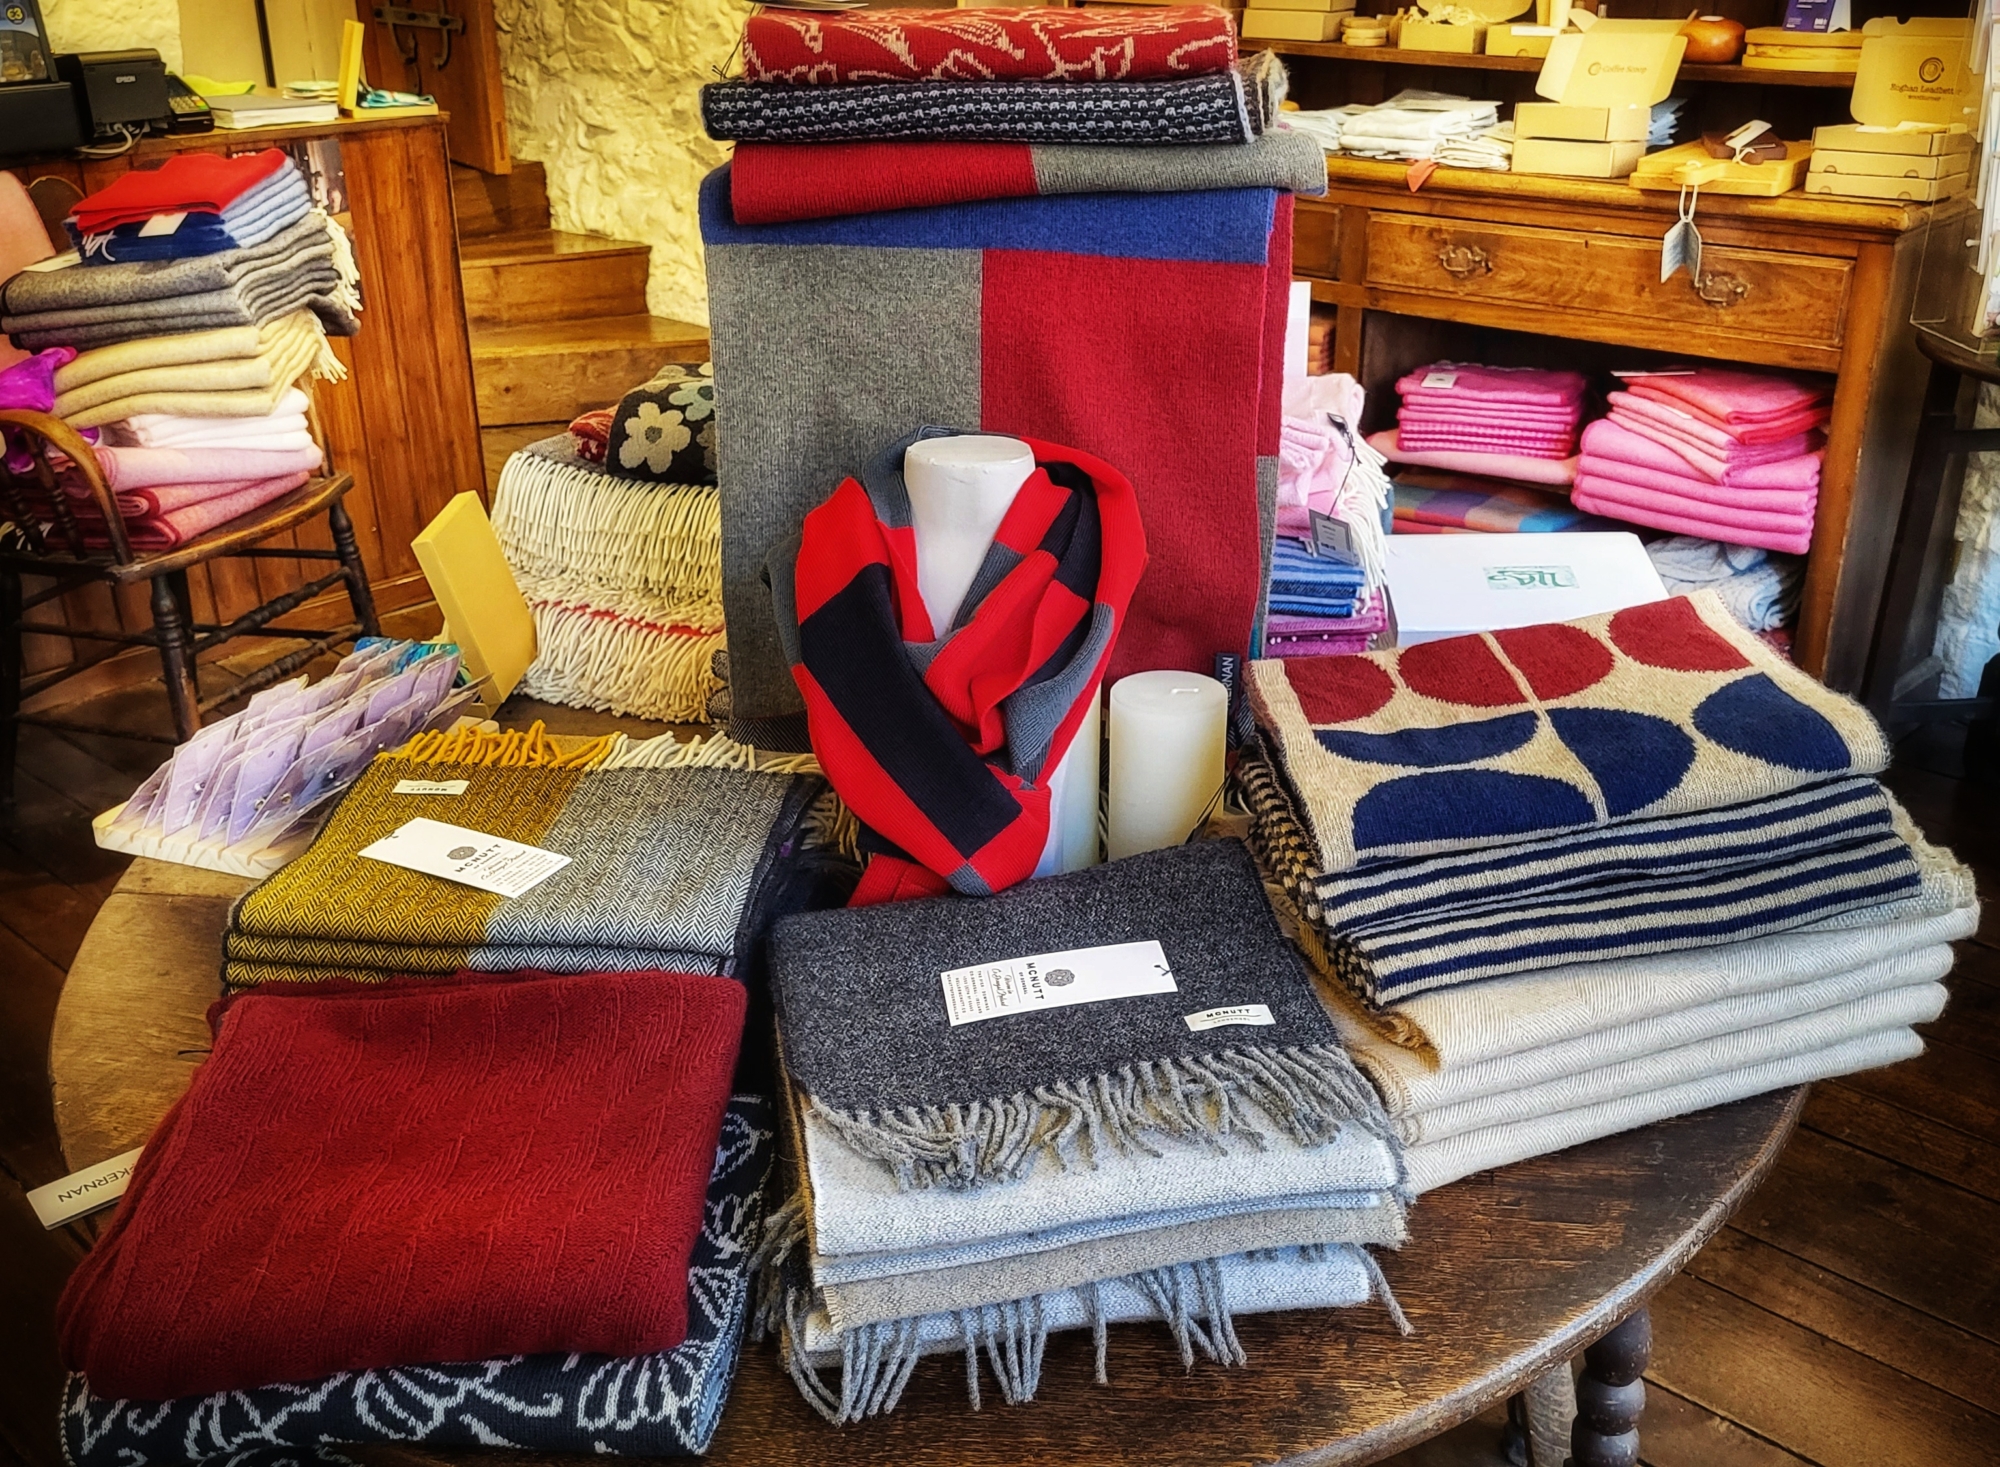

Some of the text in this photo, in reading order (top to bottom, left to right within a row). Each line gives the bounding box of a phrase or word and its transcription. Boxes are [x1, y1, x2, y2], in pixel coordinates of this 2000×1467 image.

[7, 7, 23, 20] €3
[115, 75, 136, 83] EPSON
[455, 844, 502, 873] MCNUTT
[1026, 962, 1044, 1000] MCNUTT
[1206, 1009, 1250, 1018] MCNUTT
